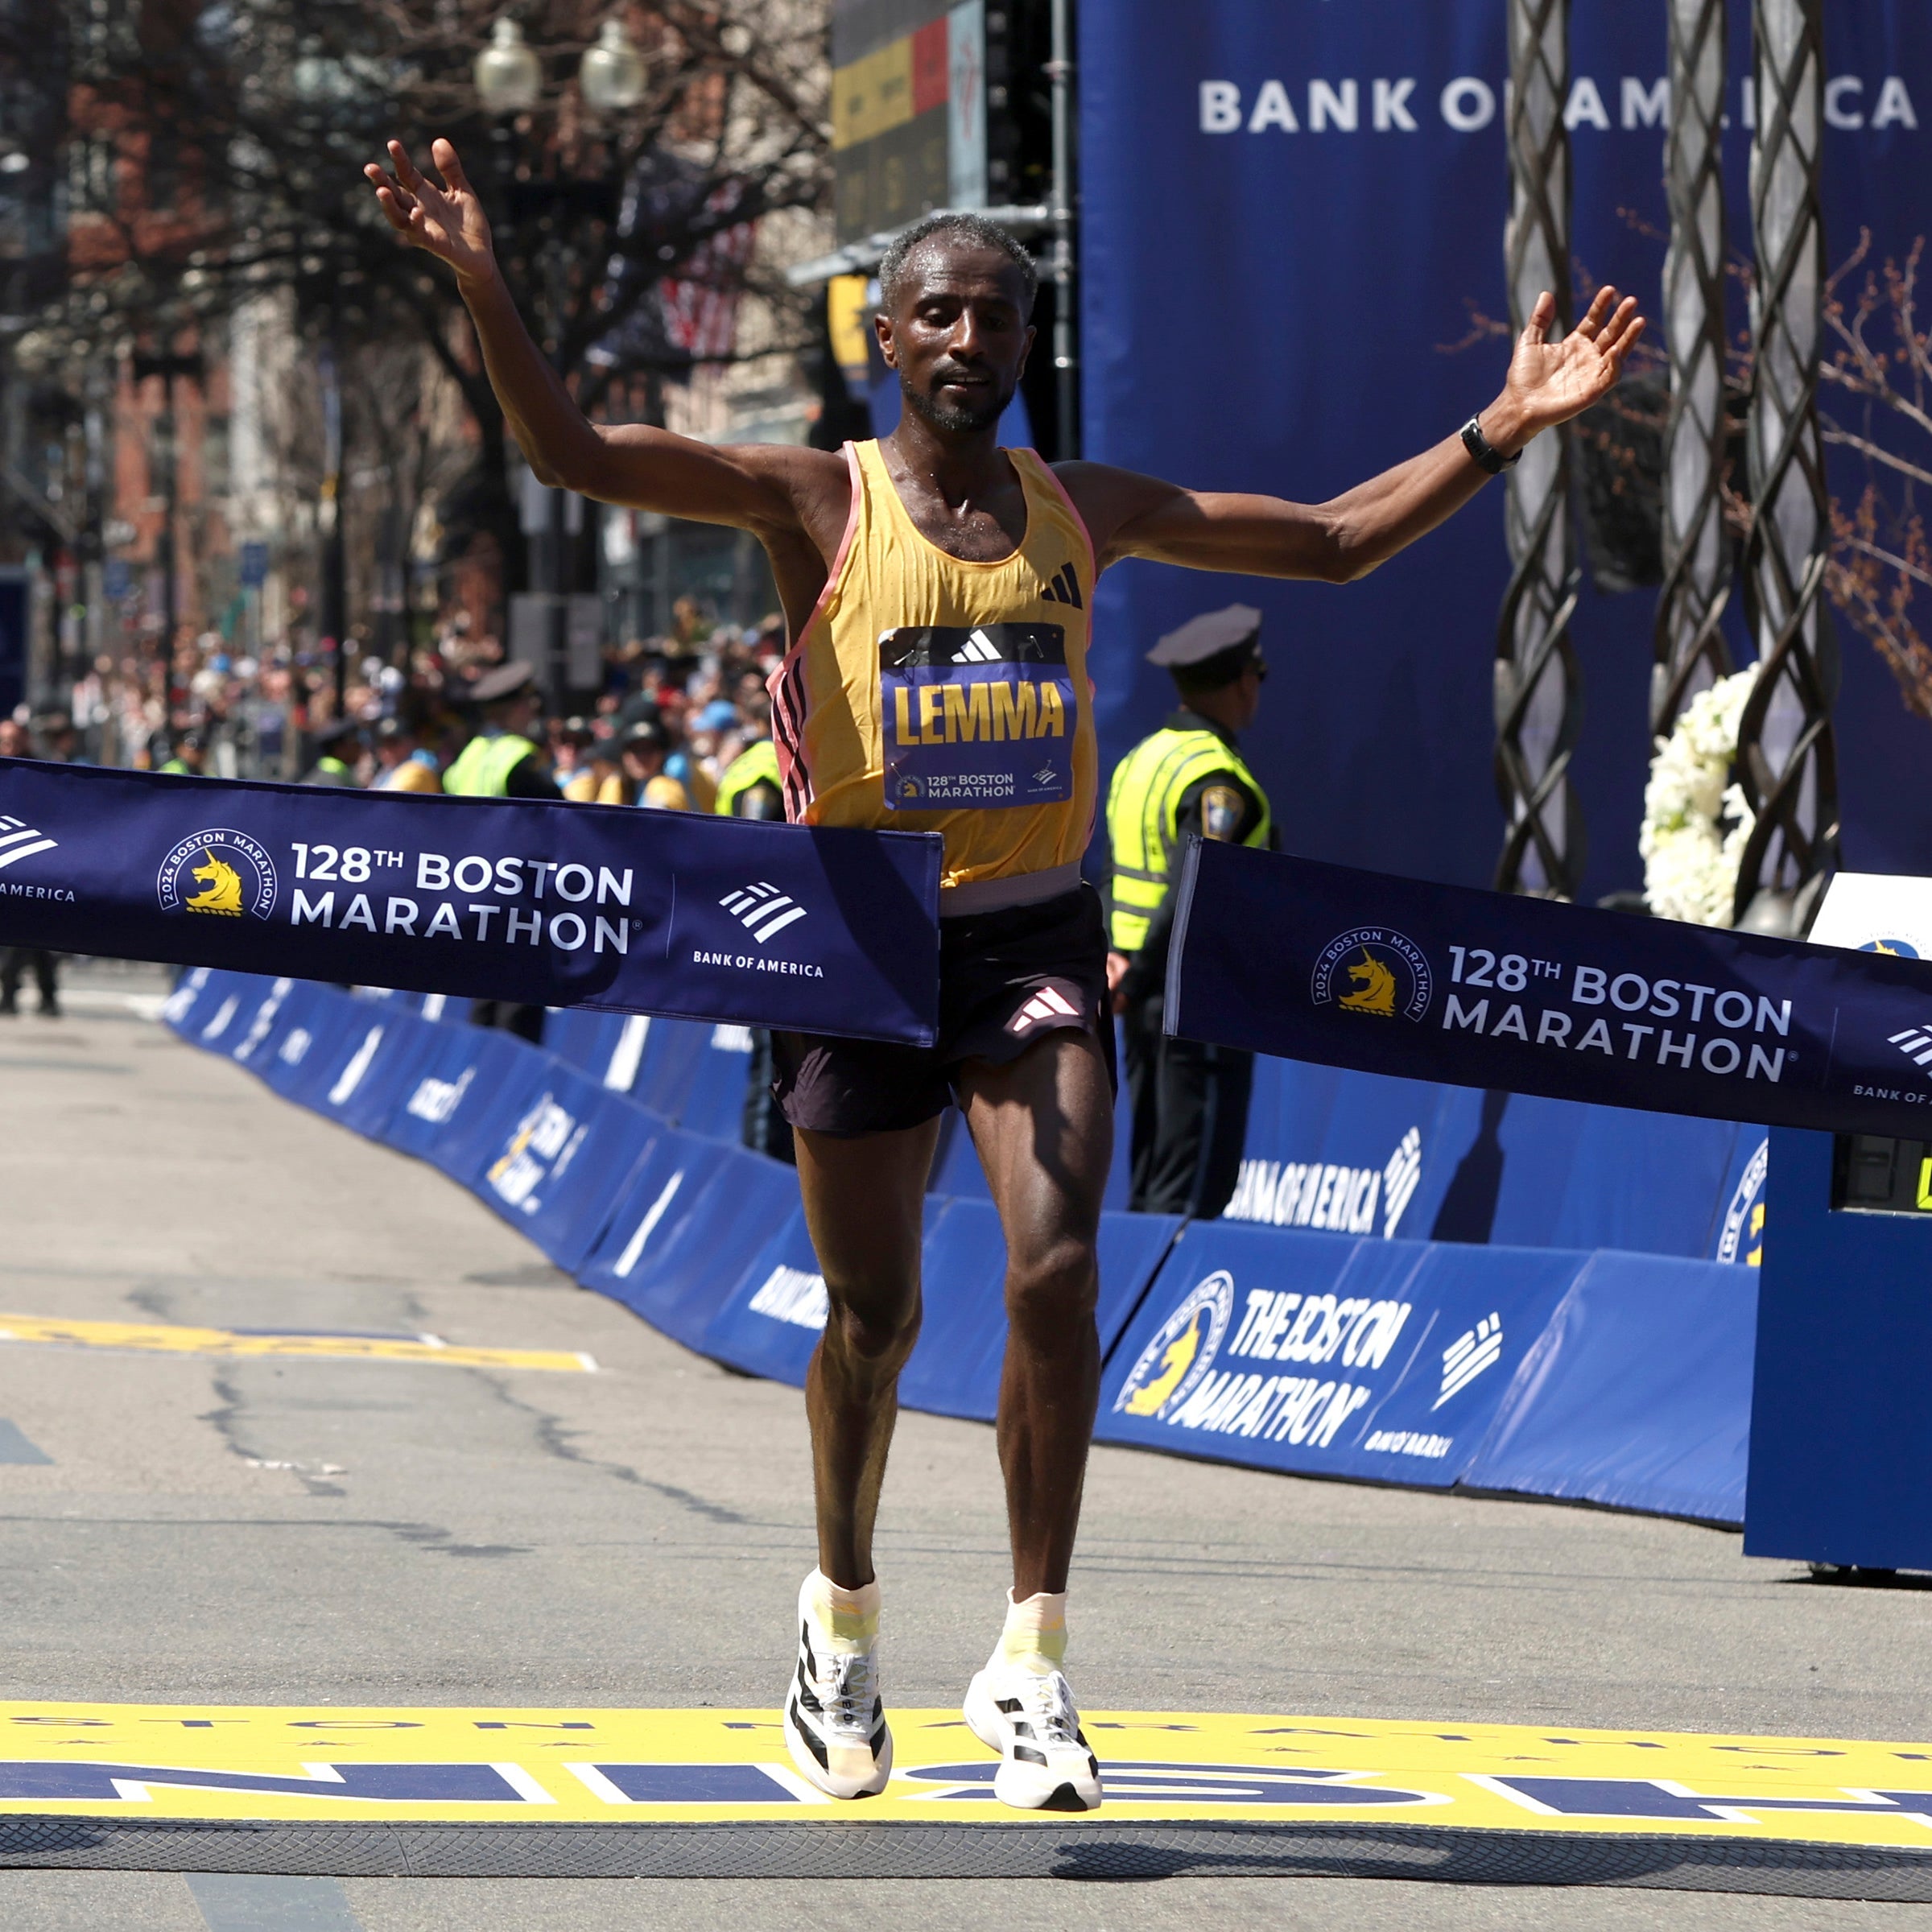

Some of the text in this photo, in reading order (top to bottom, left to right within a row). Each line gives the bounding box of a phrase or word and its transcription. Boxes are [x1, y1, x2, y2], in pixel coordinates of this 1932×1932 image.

[1199, 76, 1918, 134] BANK O AMCA
[894, 680, 1065, 745] LEMMA
[927, 775, 956, 786] 128TH
[960, 773, 1013, 786] BOSTON
[0, 882, 75, 902] AMERICA
[162, 832, 274, 910] 2024 BOSTON MARATHON
[291, 843, 633, 906] 128TH BOSTON
[693, 951, 824, 978] BANK OF AMERICA
[1316, 931, 1428, 1013] 2024 BOSTON MARATHON
[1449, 946, 1792, 1036] 128TH BOSTON
[1853, 1084, 1901, 1100] BANK
[1905, 1092, 1927, 1104] OF
[1228, 1288, 1302, 1360] THE
[1275, 1293, 1412, 1370] BOSTON
